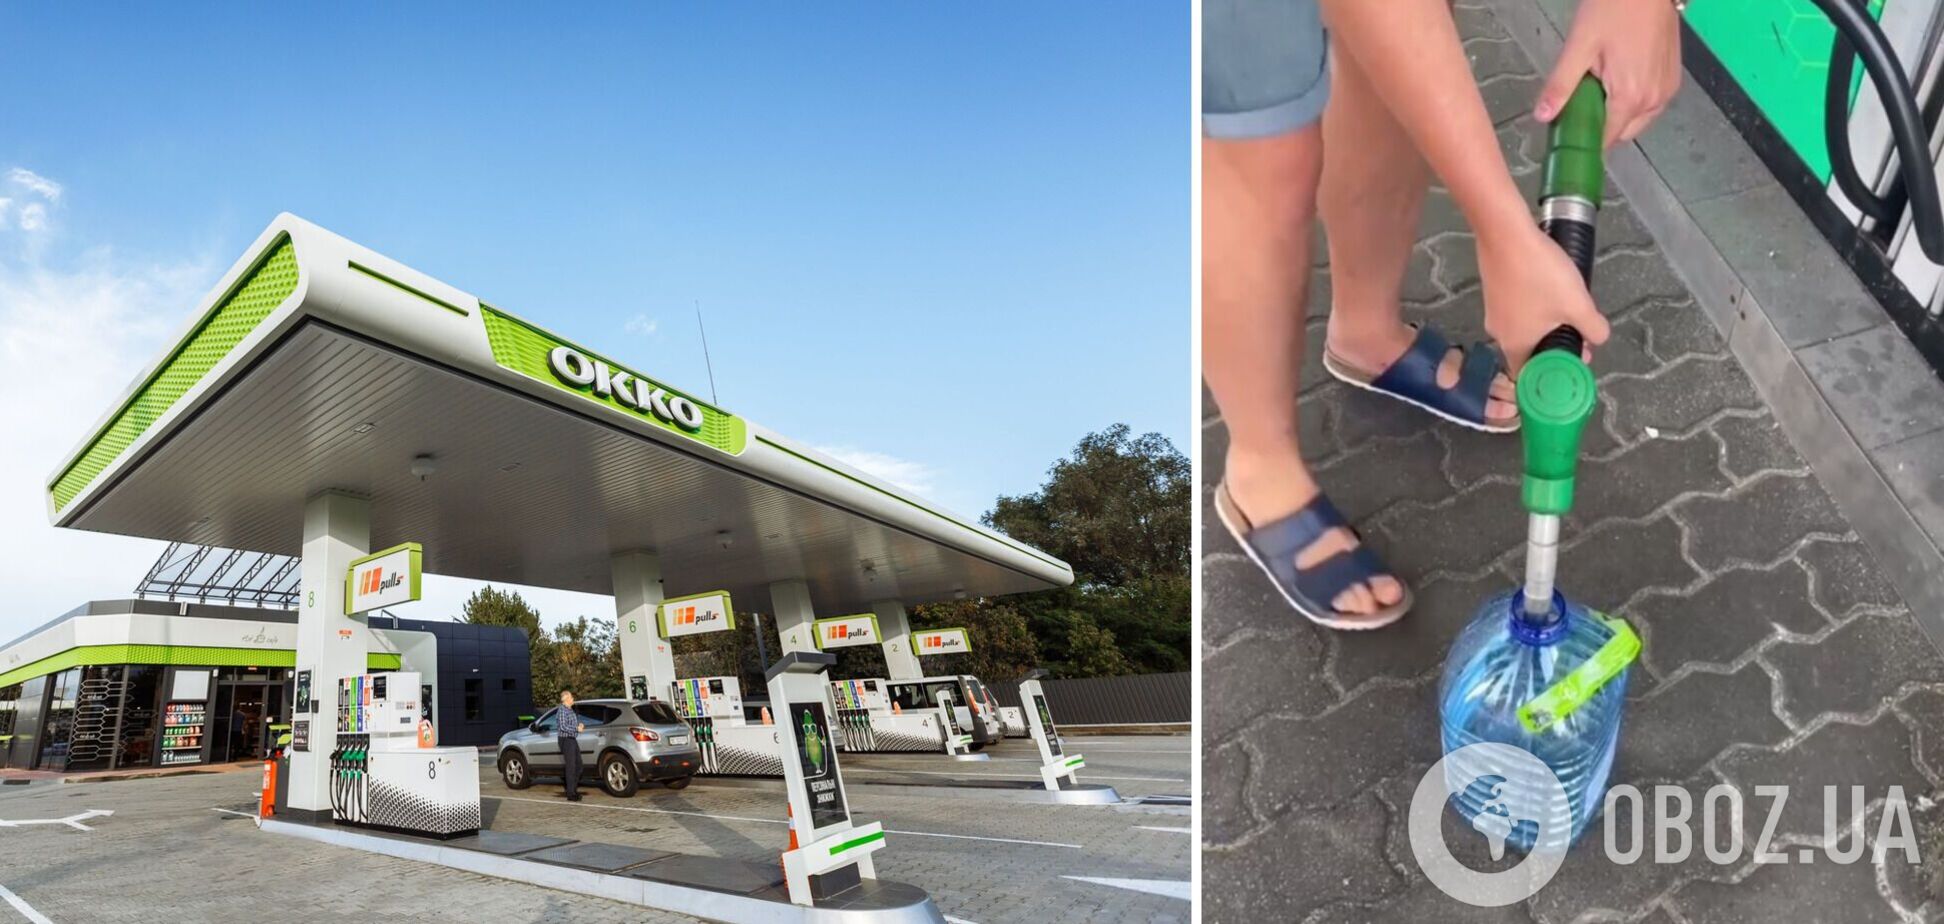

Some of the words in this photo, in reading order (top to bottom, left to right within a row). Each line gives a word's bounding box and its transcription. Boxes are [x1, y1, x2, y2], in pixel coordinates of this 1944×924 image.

[549, 346, 704, 430] OKKO
[379, 571, 404, 595] pulls
[308, 591, 315, 608] 8
[695, 610, 719, 626] pulls
[629, 620, 637, 633] 6
[790, 634, 797, 645] 4
[891, 644, 899, 652] 2
[1007, 711, 1014, 719] 2
[922, 718, 929, 728] 4
[428, 761, 436, 780] 8
